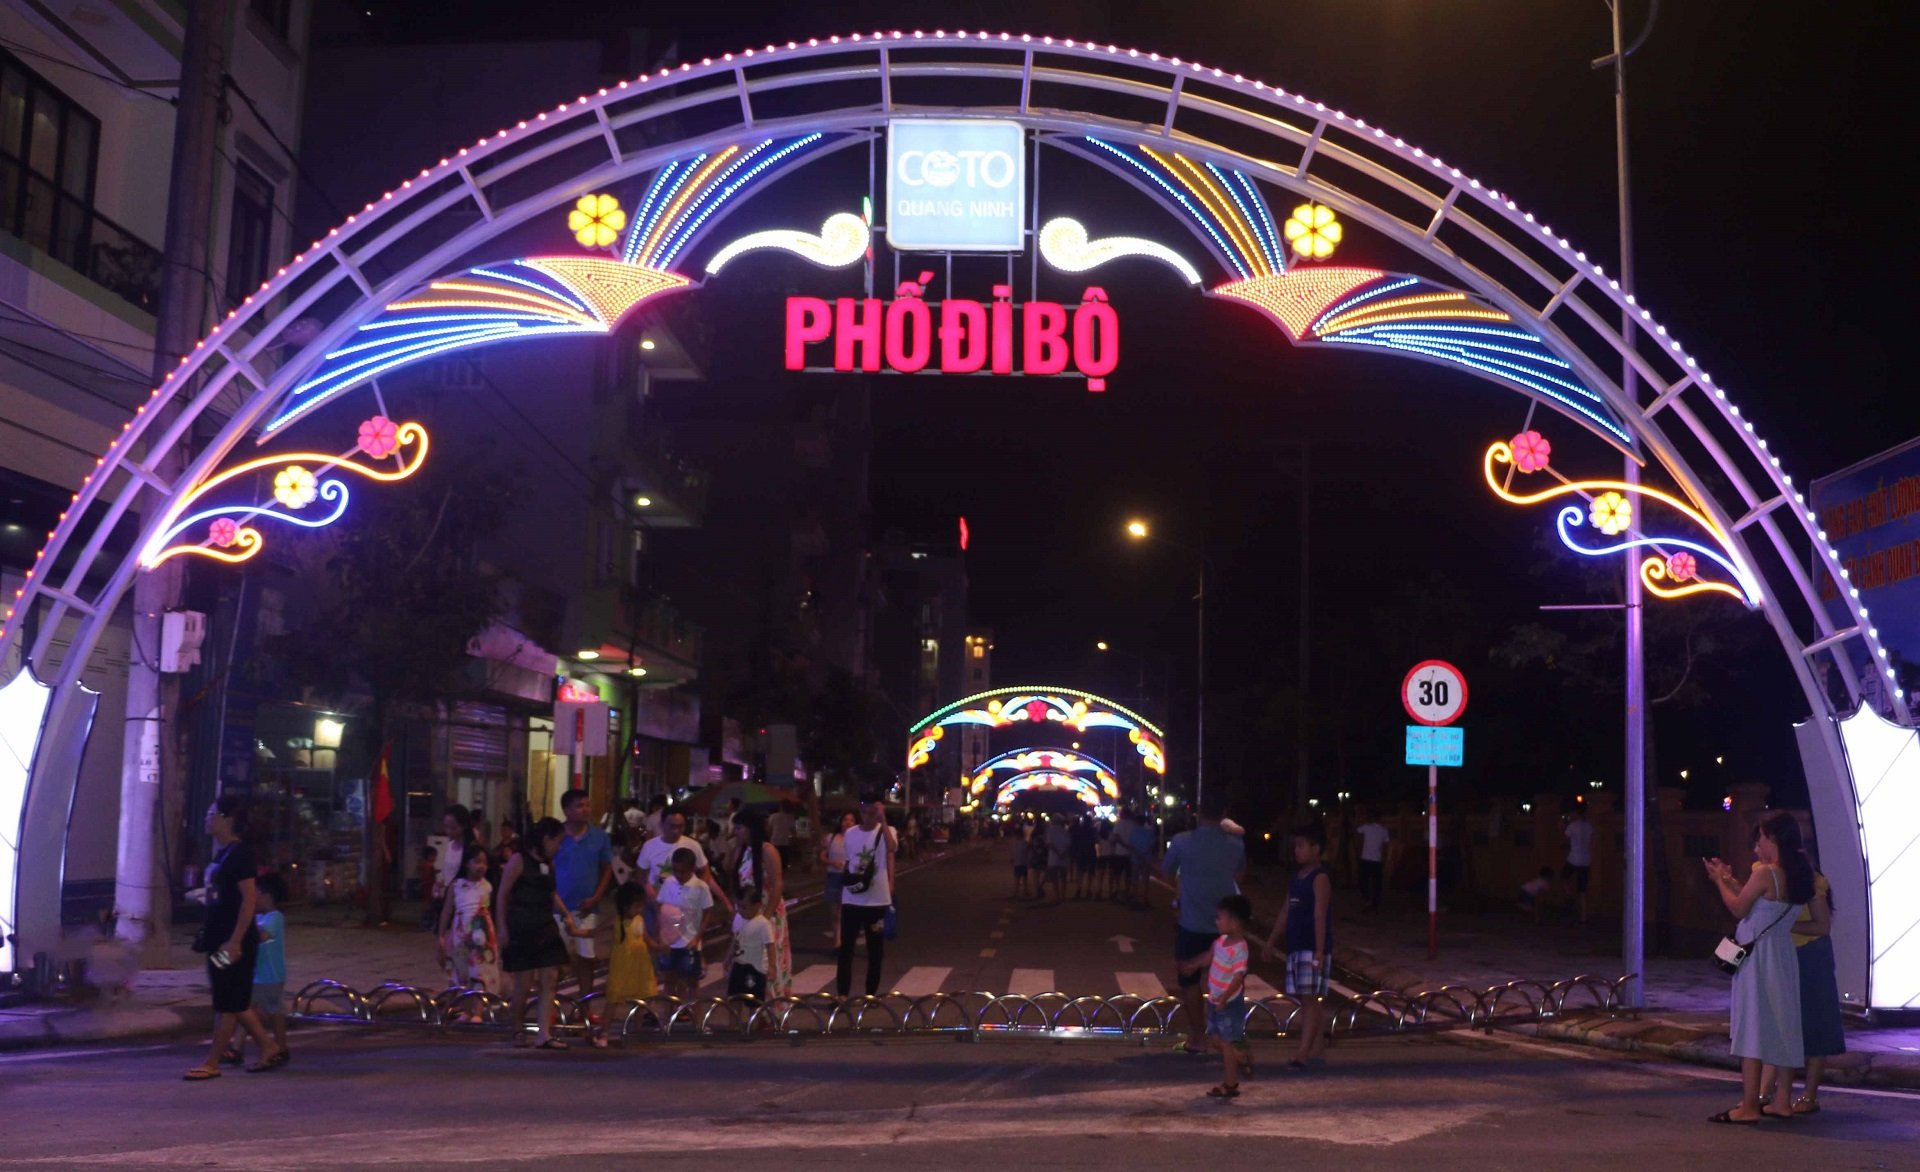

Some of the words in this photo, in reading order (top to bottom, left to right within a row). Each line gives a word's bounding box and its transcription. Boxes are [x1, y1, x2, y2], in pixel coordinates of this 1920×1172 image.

[898, 199, 964, 217] QUANG
[969, 201, 1015, 218] NINH
[785, 271, 935, 373] PHỐ
[1023, 286, 1119, 392] BỘ
[1419, 681, 1448, 706] 30
